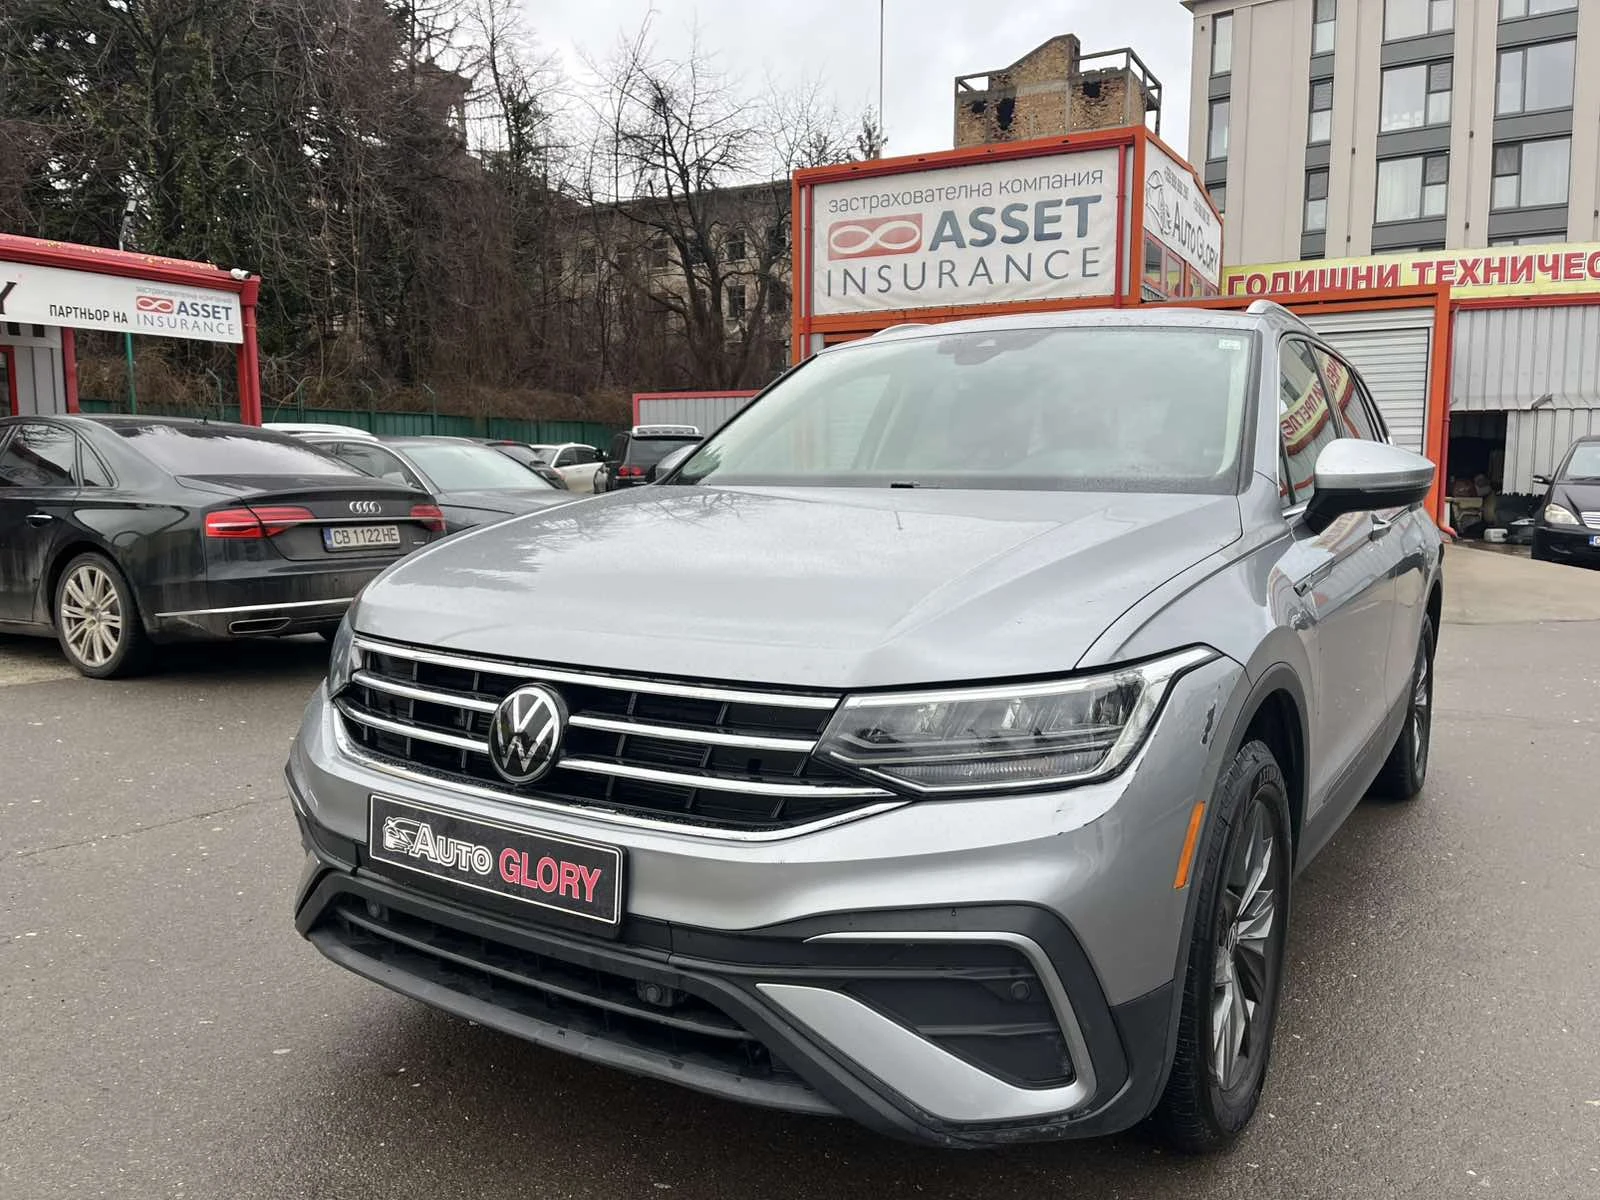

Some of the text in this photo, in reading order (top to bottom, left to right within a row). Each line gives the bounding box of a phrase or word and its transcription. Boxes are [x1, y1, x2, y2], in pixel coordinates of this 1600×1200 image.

[828, 168, 1104, 214] застрахователна компания
[928, 194, 1102, 251] ASSET
[826, 246, 1101, 297] INSURANCE
[1227, 263, 1400, 296] ГОДИШНИ
[49, 304, 129, 324] ПАРТНЬОР НА
[136, 313, 235, 336] INSURANCE
[176, 300, 233, 321] ASSET
[333, 530, 351, 545] CB
[499, 847, 602, 903] GLORY
